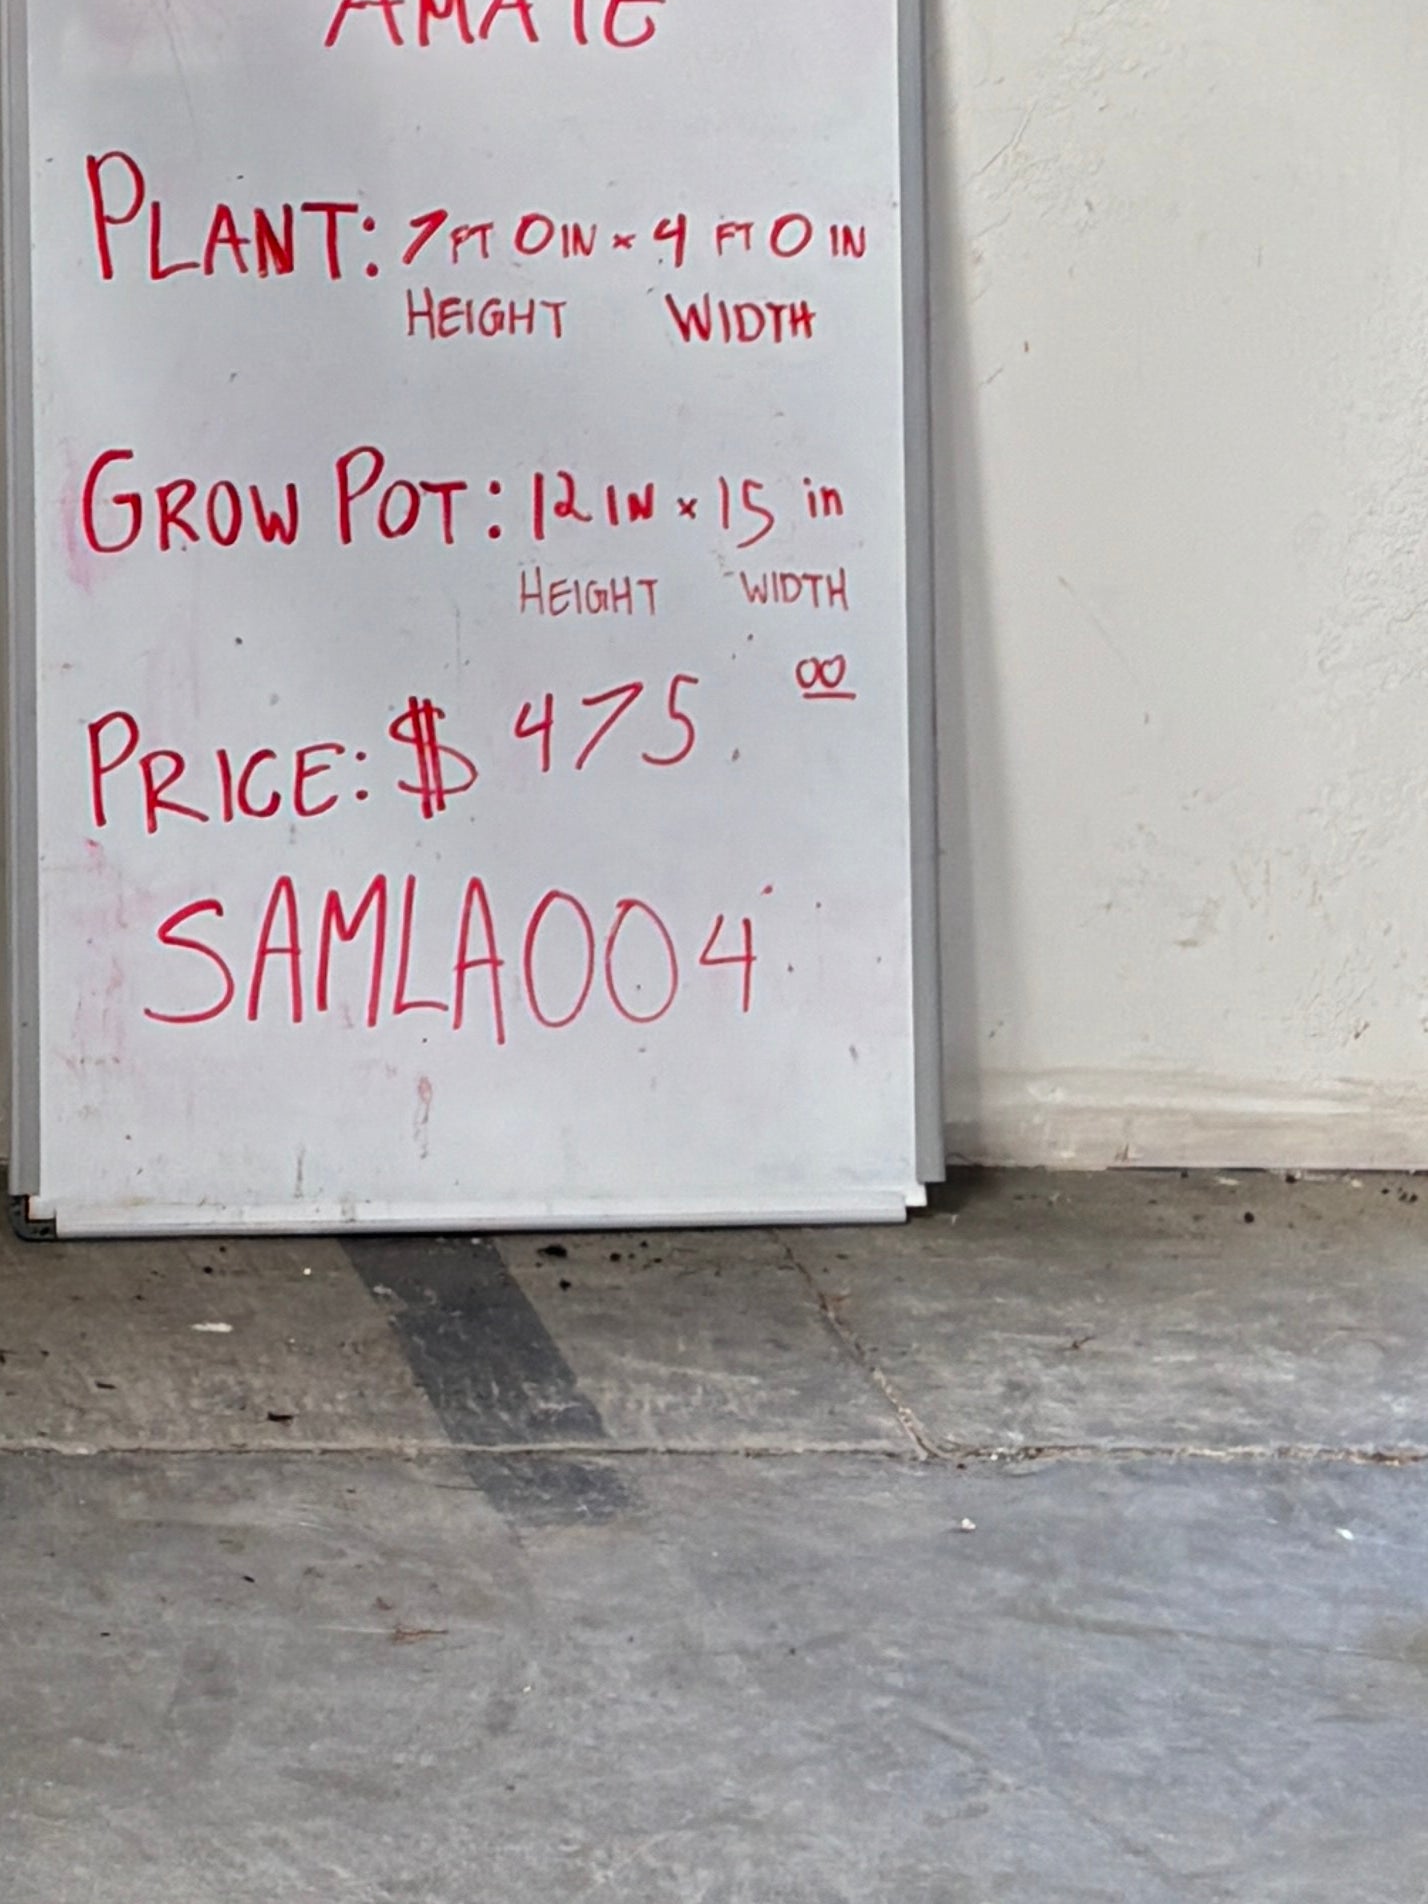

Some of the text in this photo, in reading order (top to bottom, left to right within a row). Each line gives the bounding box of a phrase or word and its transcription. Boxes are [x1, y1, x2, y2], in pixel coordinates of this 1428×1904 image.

[84, 151, 382, 282] PLANT:
[406, 287, 568, 341] HEIGHT
[664, 293, 817, 344] WIDTH
[83, 448, 300, 554] GROW
[336, 446, 504, 546] POT:
[718, 474, 775, 548] 15
[518, 566, 660, 618] HEIGHT
[741, 569, 851, 612] WIDTH
[87, 710, 370, 835] PRICE:
